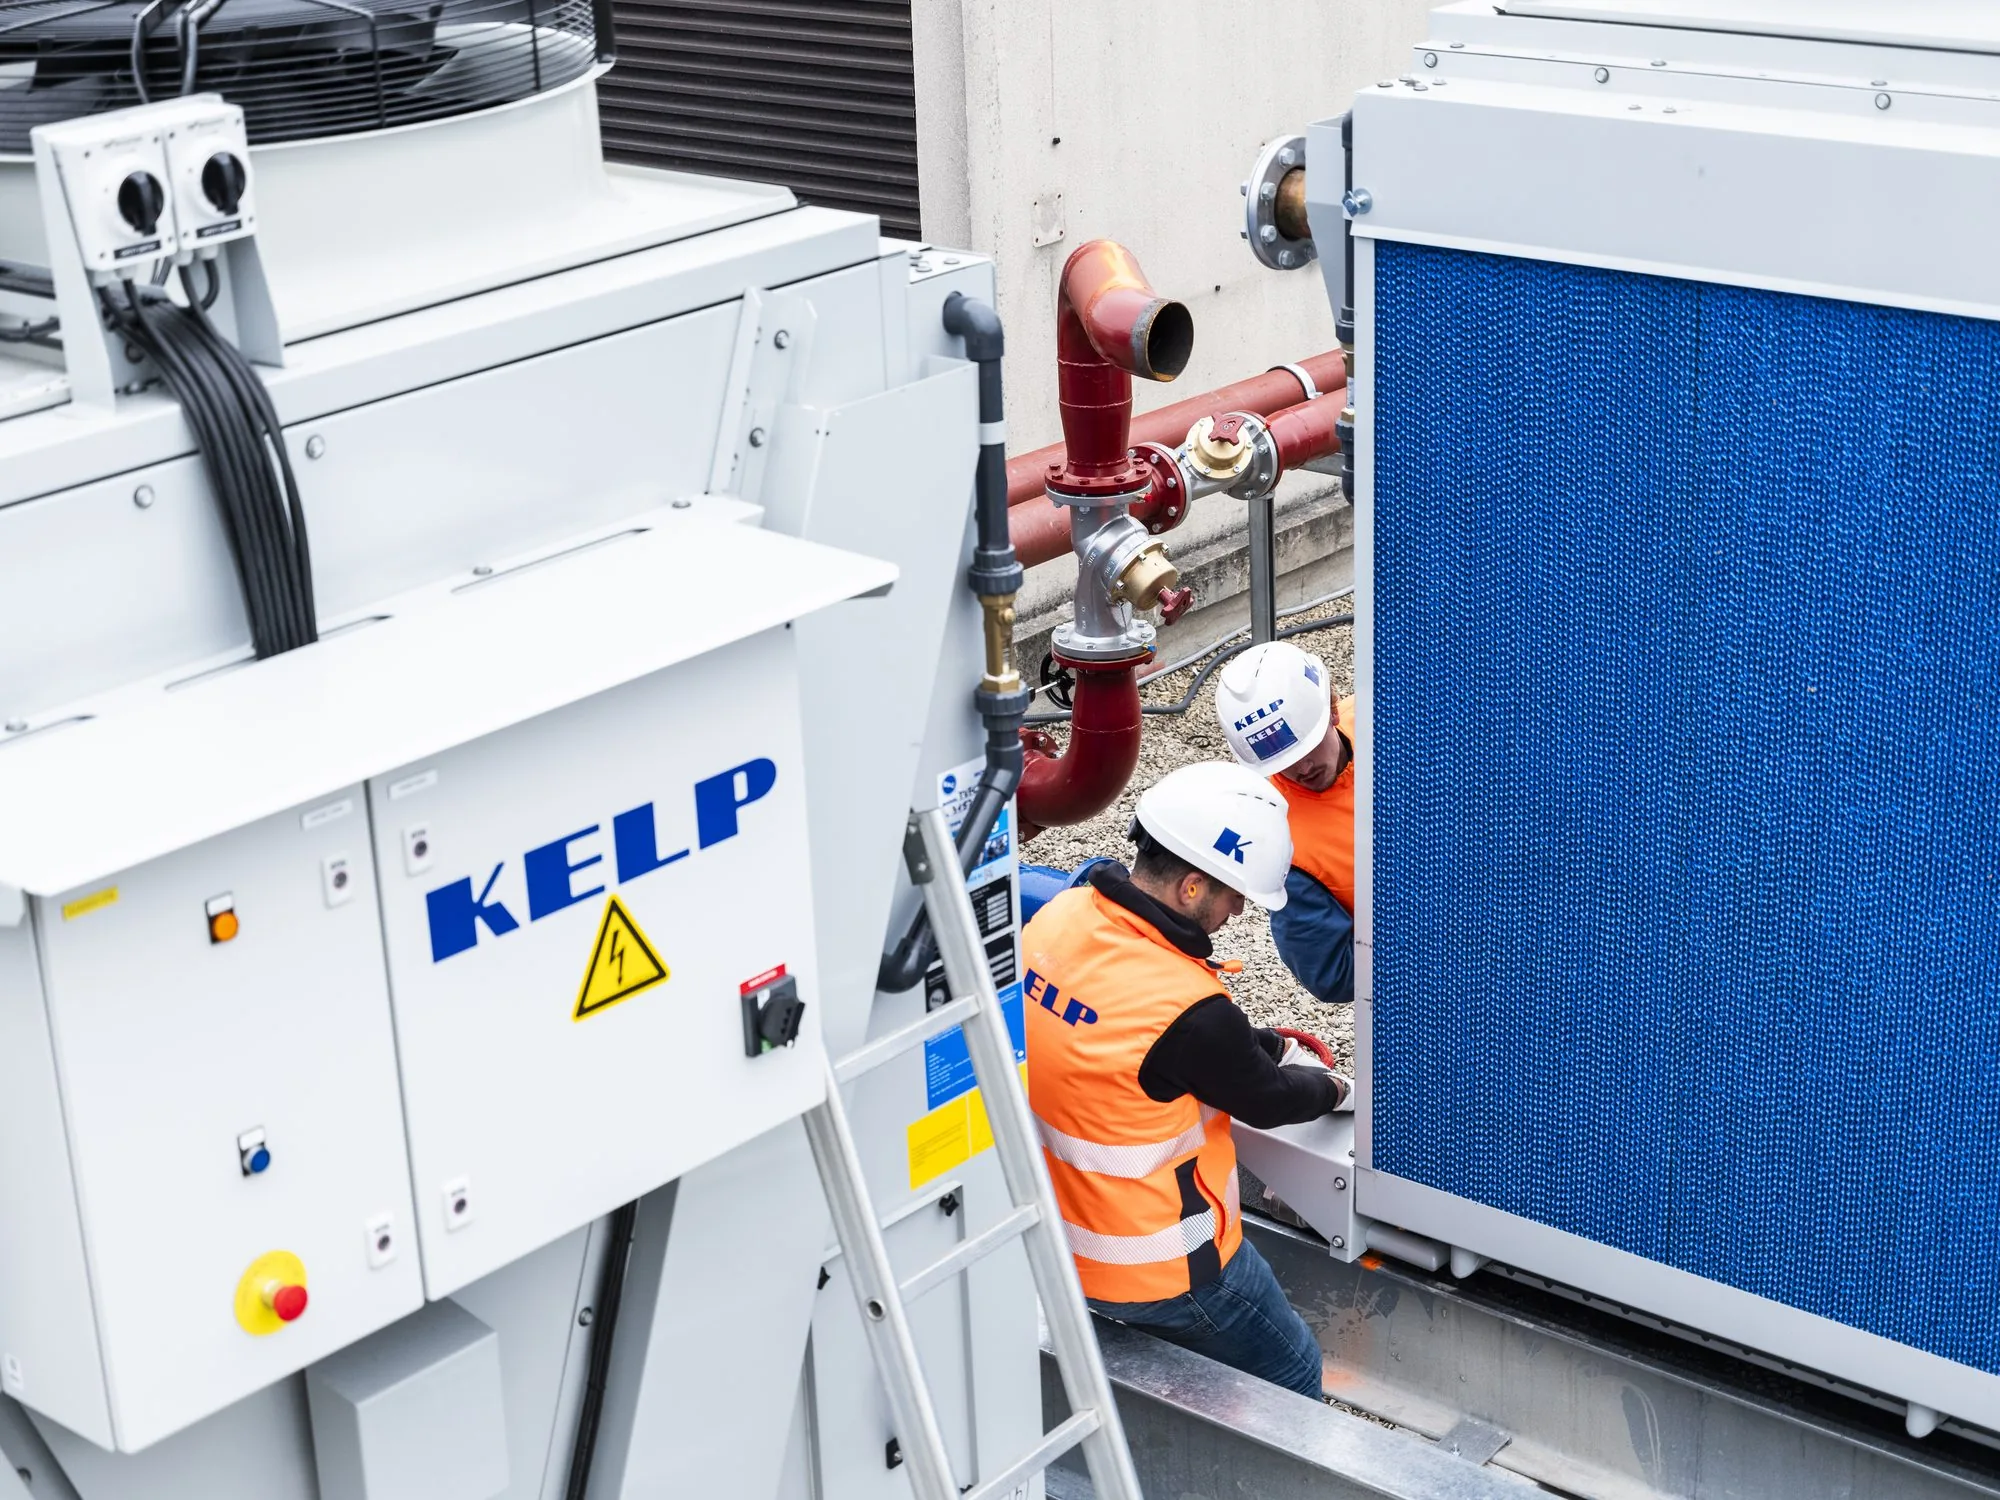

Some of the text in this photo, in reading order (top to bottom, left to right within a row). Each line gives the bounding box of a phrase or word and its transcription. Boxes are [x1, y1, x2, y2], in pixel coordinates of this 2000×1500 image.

[1234, 699, 1284, 731] KELP
[1247, 720, 1285, 745] KELP
[425, 758, 777, 963] KELP
[1213, 827, 1253, 864] K
[1024, 968, 1098, 1027] ELP
